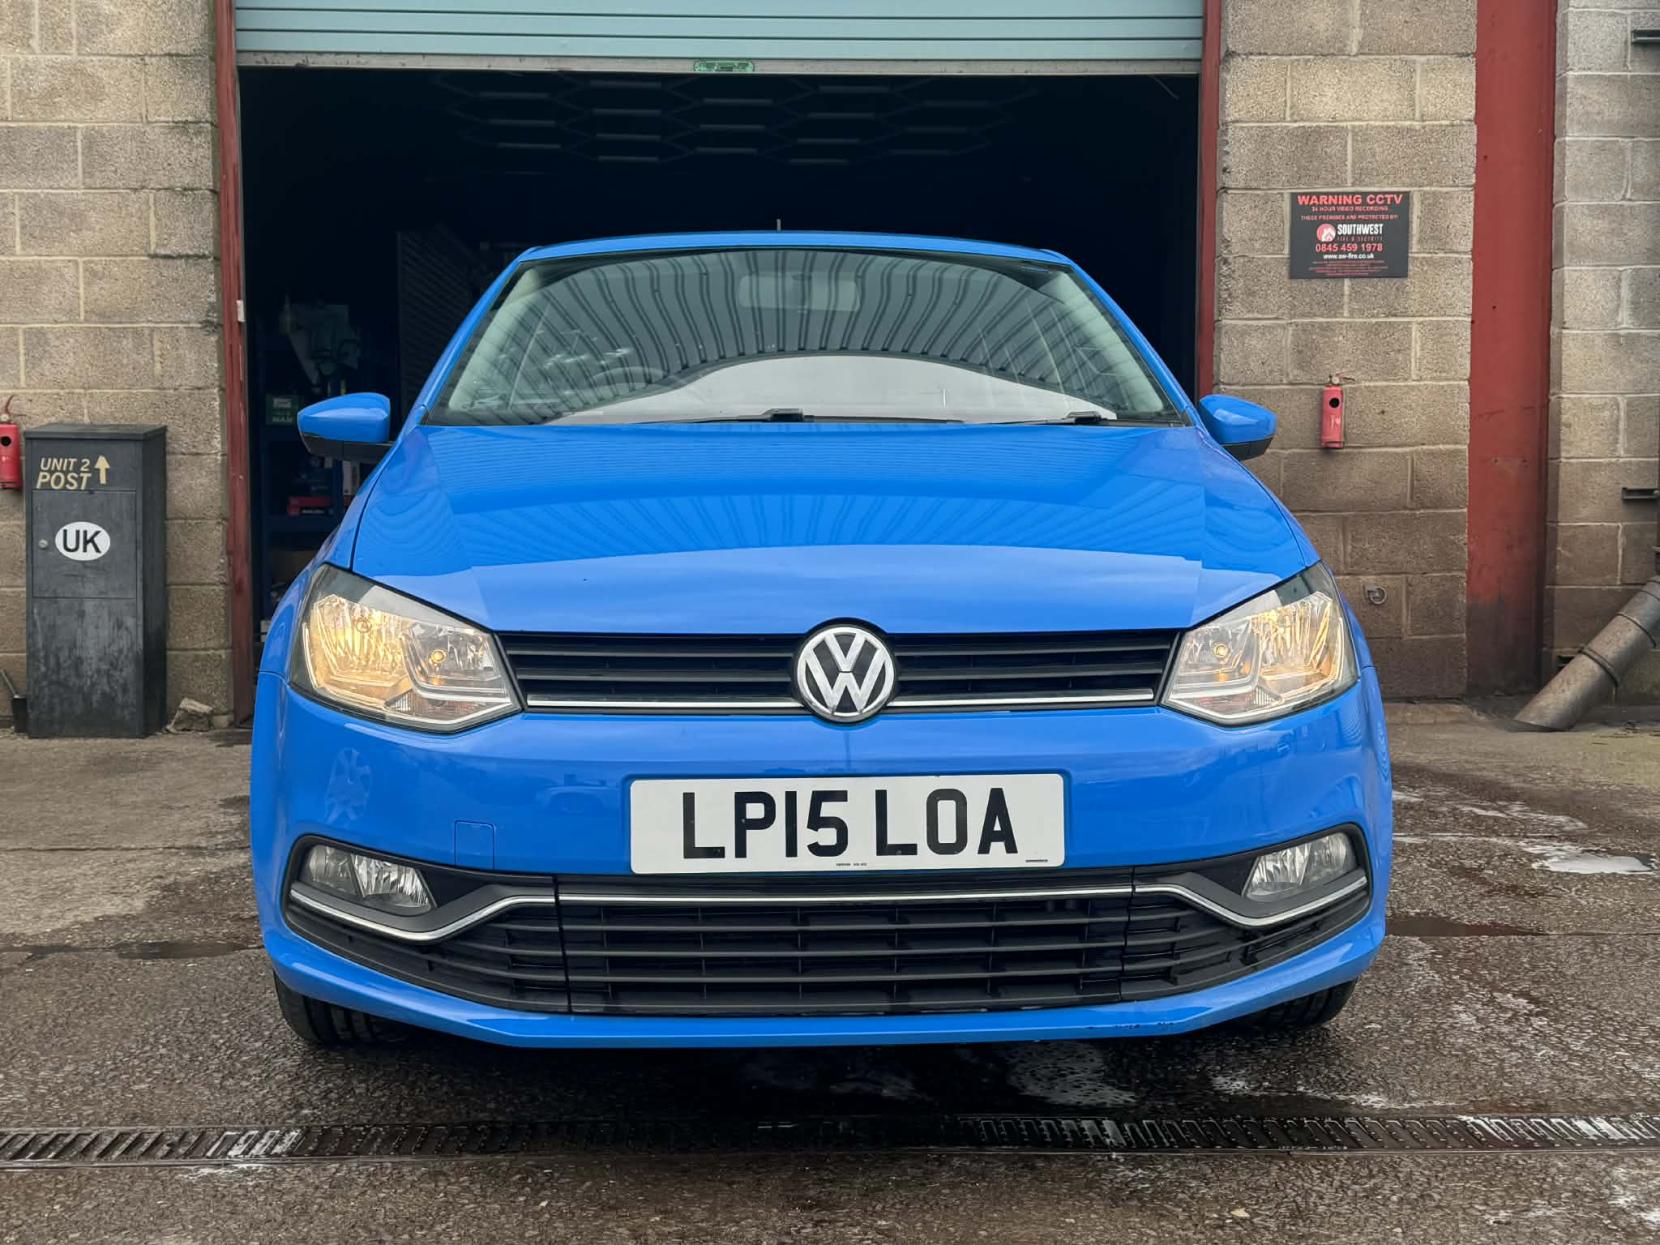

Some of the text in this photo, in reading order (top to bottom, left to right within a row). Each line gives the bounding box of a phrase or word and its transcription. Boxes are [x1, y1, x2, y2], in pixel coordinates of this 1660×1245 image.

[1297, 194, 1403, 205] WARNING CCTV
[1337, 223, 1383, 235] SOUTHWEST
[1315, 243, 1383, 253] 0845 459 1978
[40, 457, 90, 471] UNIT 2
[36, 472, 92, 490] POST
[62, 528, 102, 554] UK
[803, 630, 889, 716] VW
[682, 787, 1018, 859] LP15 LOA
